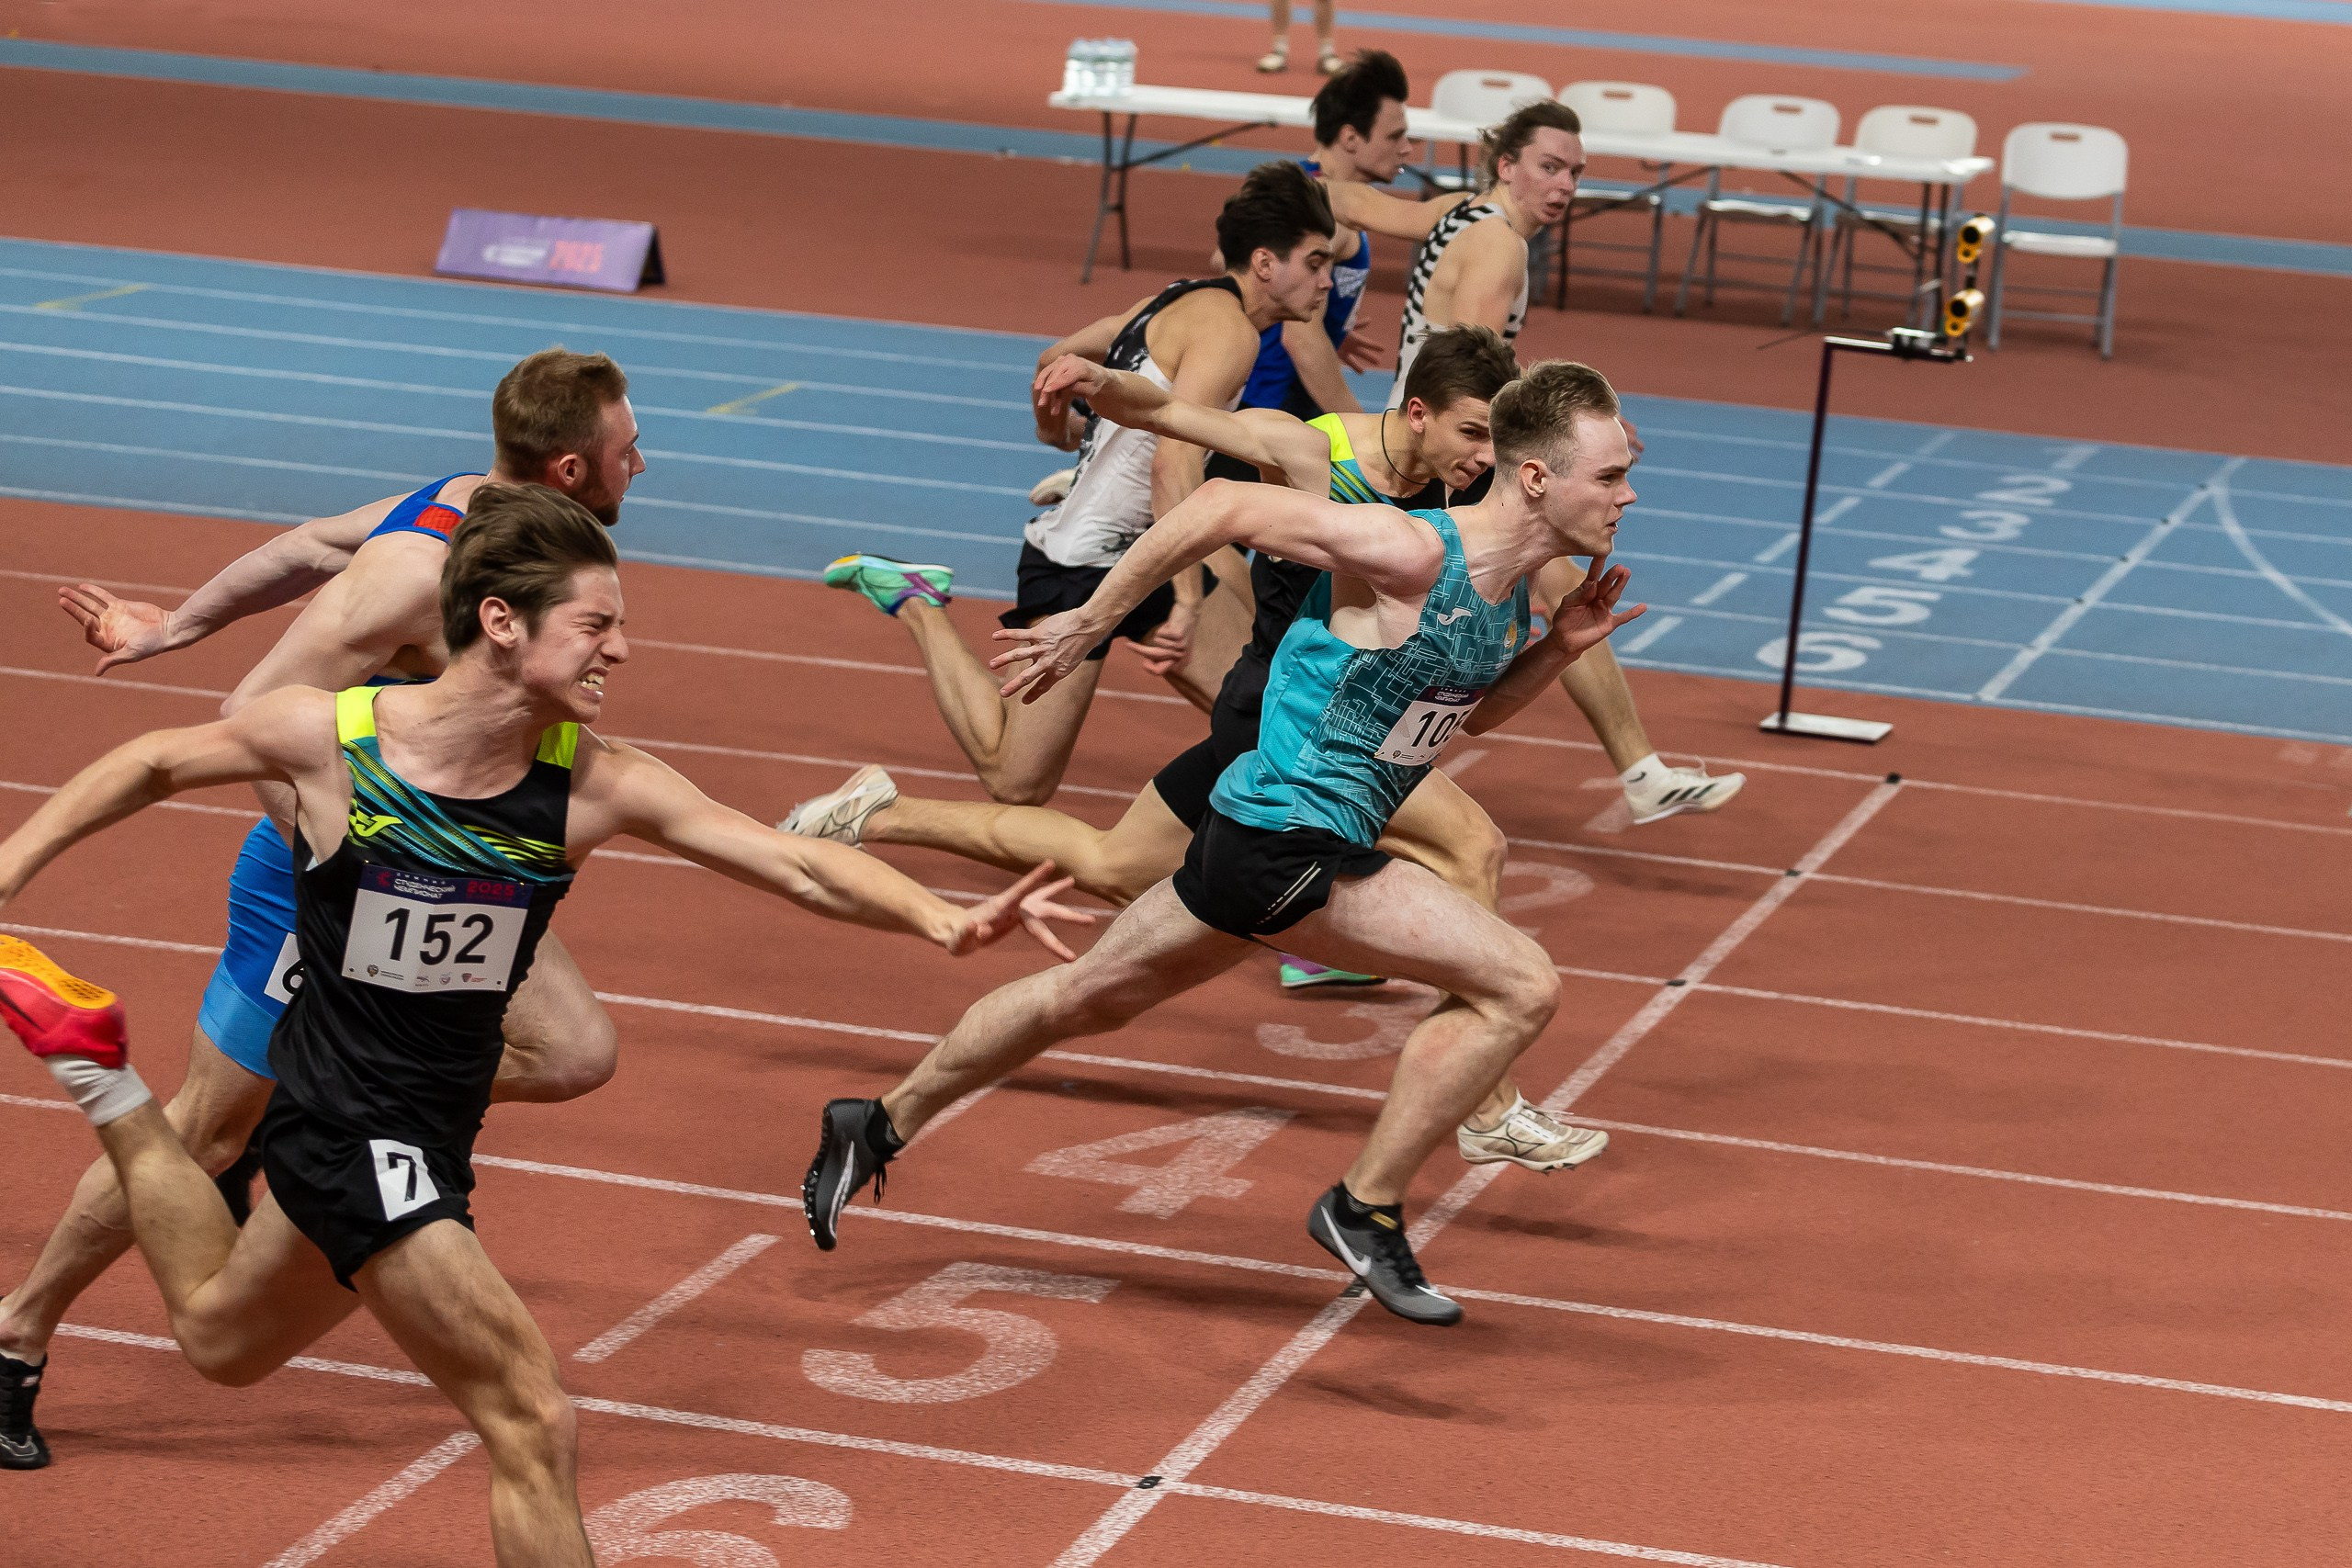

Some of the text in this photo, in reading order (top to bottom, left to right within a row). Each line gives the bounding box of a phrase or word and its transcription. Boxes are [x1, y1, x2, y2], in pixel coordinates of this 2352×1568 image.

[1976, 475, 2072, 507] 2
[1939, 510, 2030, 542] 3
[1866, 548, 1980, 581] 4
[1822, 586, 1941, 625] 5
[1756, 632, 1883, 671] 6
[466, 880, 515, 897] 2025
[385, 908, 494, 965] 152
[1255, 977, 1441, 1060] 3
[387, 1152, 418, 1202] 7
[1023, 1107, 1298, 1219] 4
[802, 1261, 1121, 1404] 5
